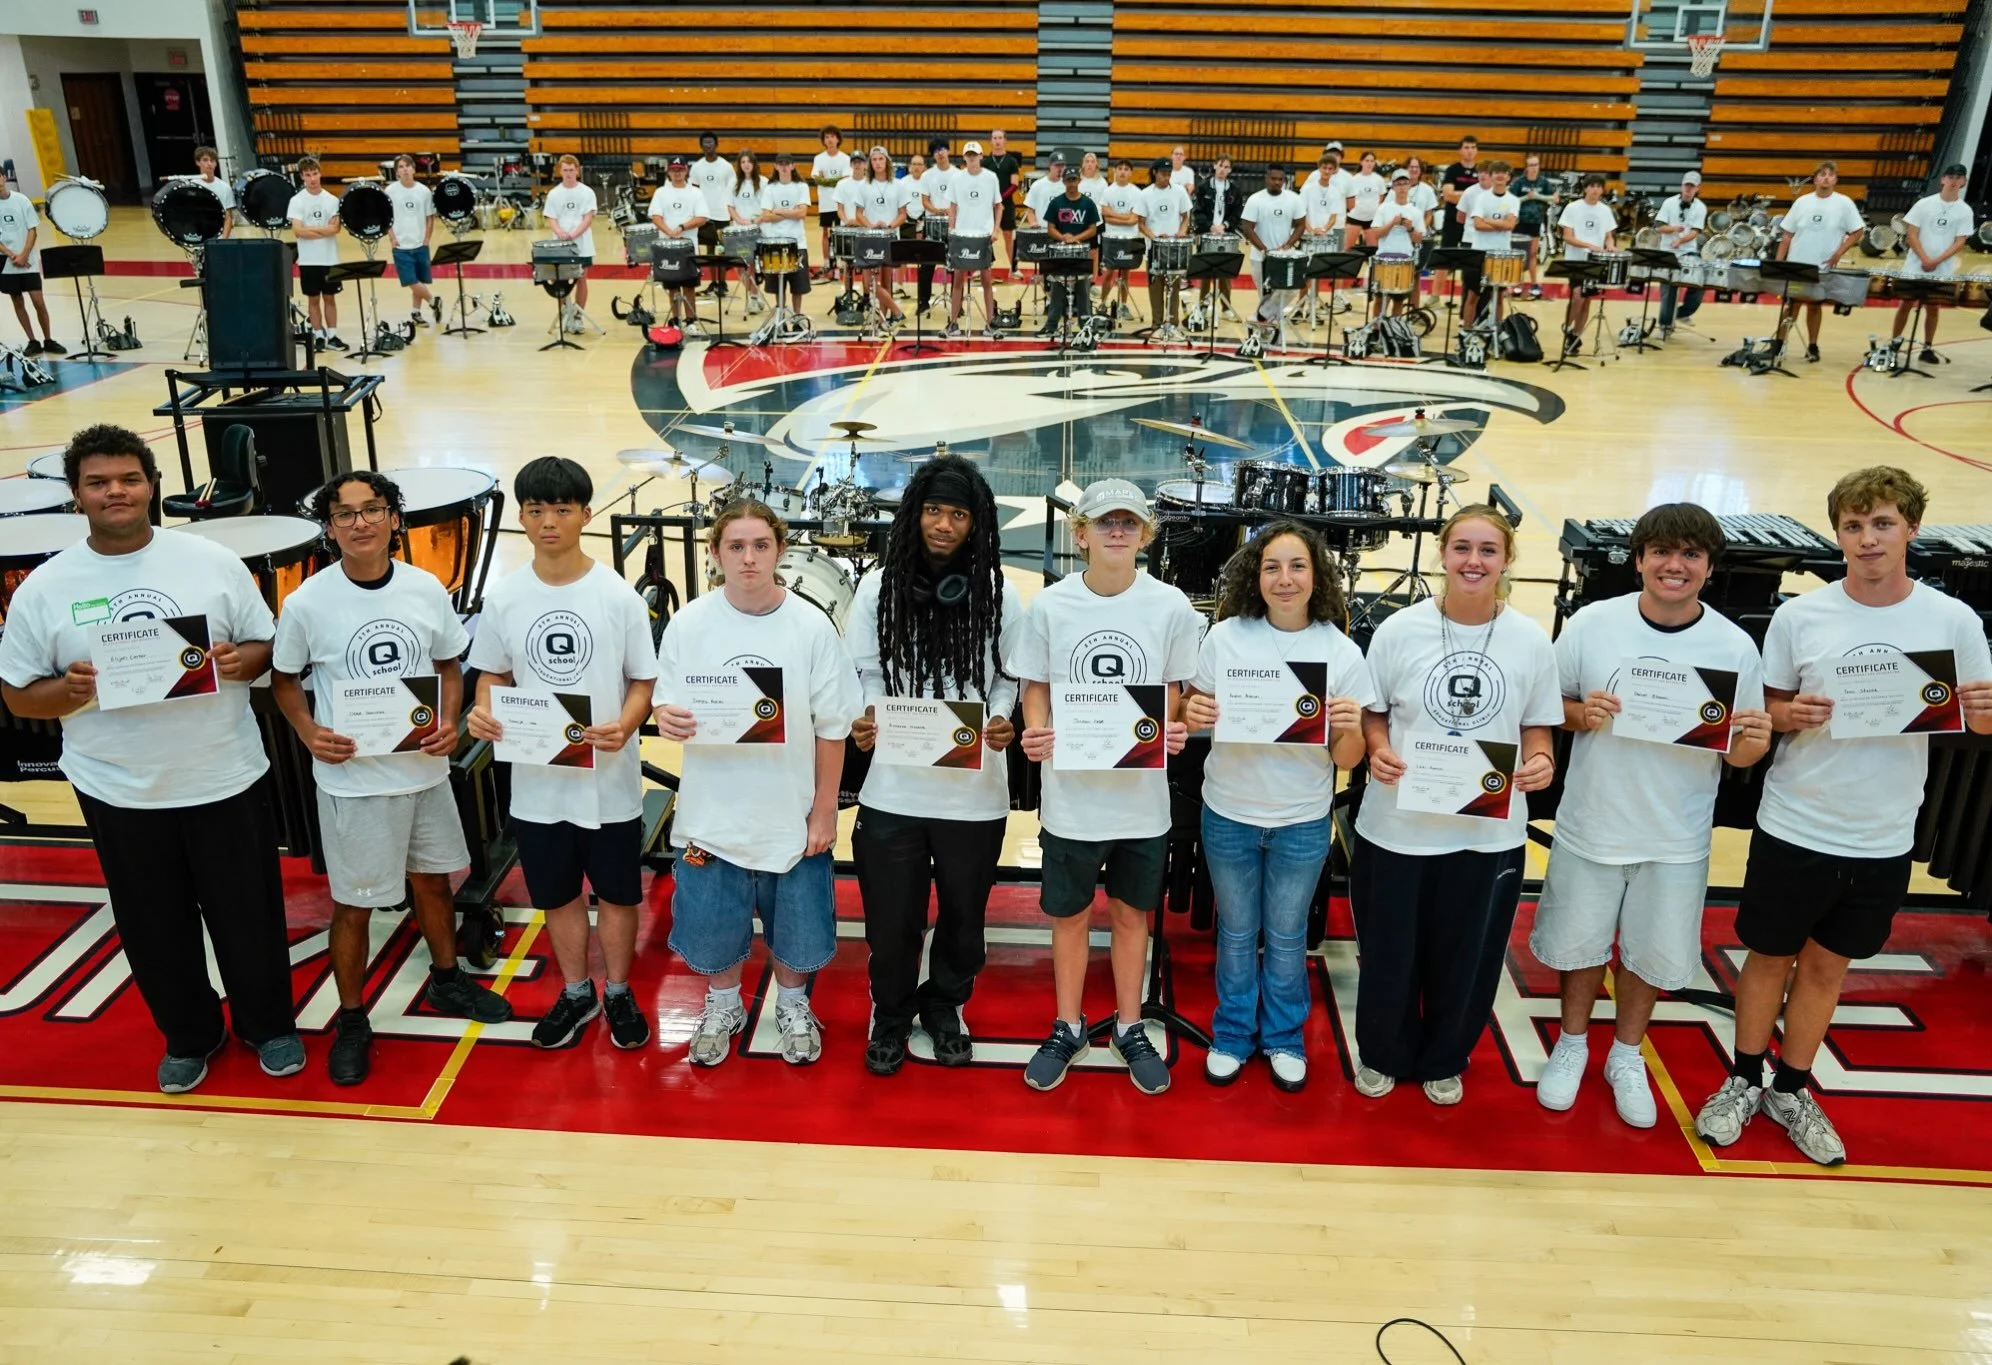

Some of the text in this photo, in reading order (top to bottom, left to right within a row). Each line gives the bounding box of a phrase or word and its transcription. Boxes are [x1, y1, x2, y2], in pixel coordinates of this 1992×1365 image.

[1951, 558, 1989, 569] majestic
[128, 593, 162, 603] ANNUAL
[374, 624, 404, 634] ANNUAL
[101, 628, 159, 643] CERTIFICATE
[546, 633, 576, 655] Q
[1103, 635, 1133, 649] ANNUAL
[368, 641, 402, 665] Q
[548, 656, 576, 664] school
[1091, 654, 1126, 677] Q
[372, 663, 401, 676] school
[1227, 669, 1280, 678] CERTIFICATE
[1836, 662, 1899, 675] CERTIFICATE
[685, 676, 738, 684] CERTIFICATE
[1631, 668, 1687, 682] CERTIFICATE
[344, 686, 395, 698] CERTIFICATE
[1447, 675, 1483, 698] Q
[501, 696, 549, 707] CERTIFICATE
[1065, 694, 1118, 702] CERTIFICATE
[1447, 699, 1480, 708] schol
[886, 704, 938, 714] CERTIFICATE
[1415, 741, 1469, 754] CERTIFICATE
